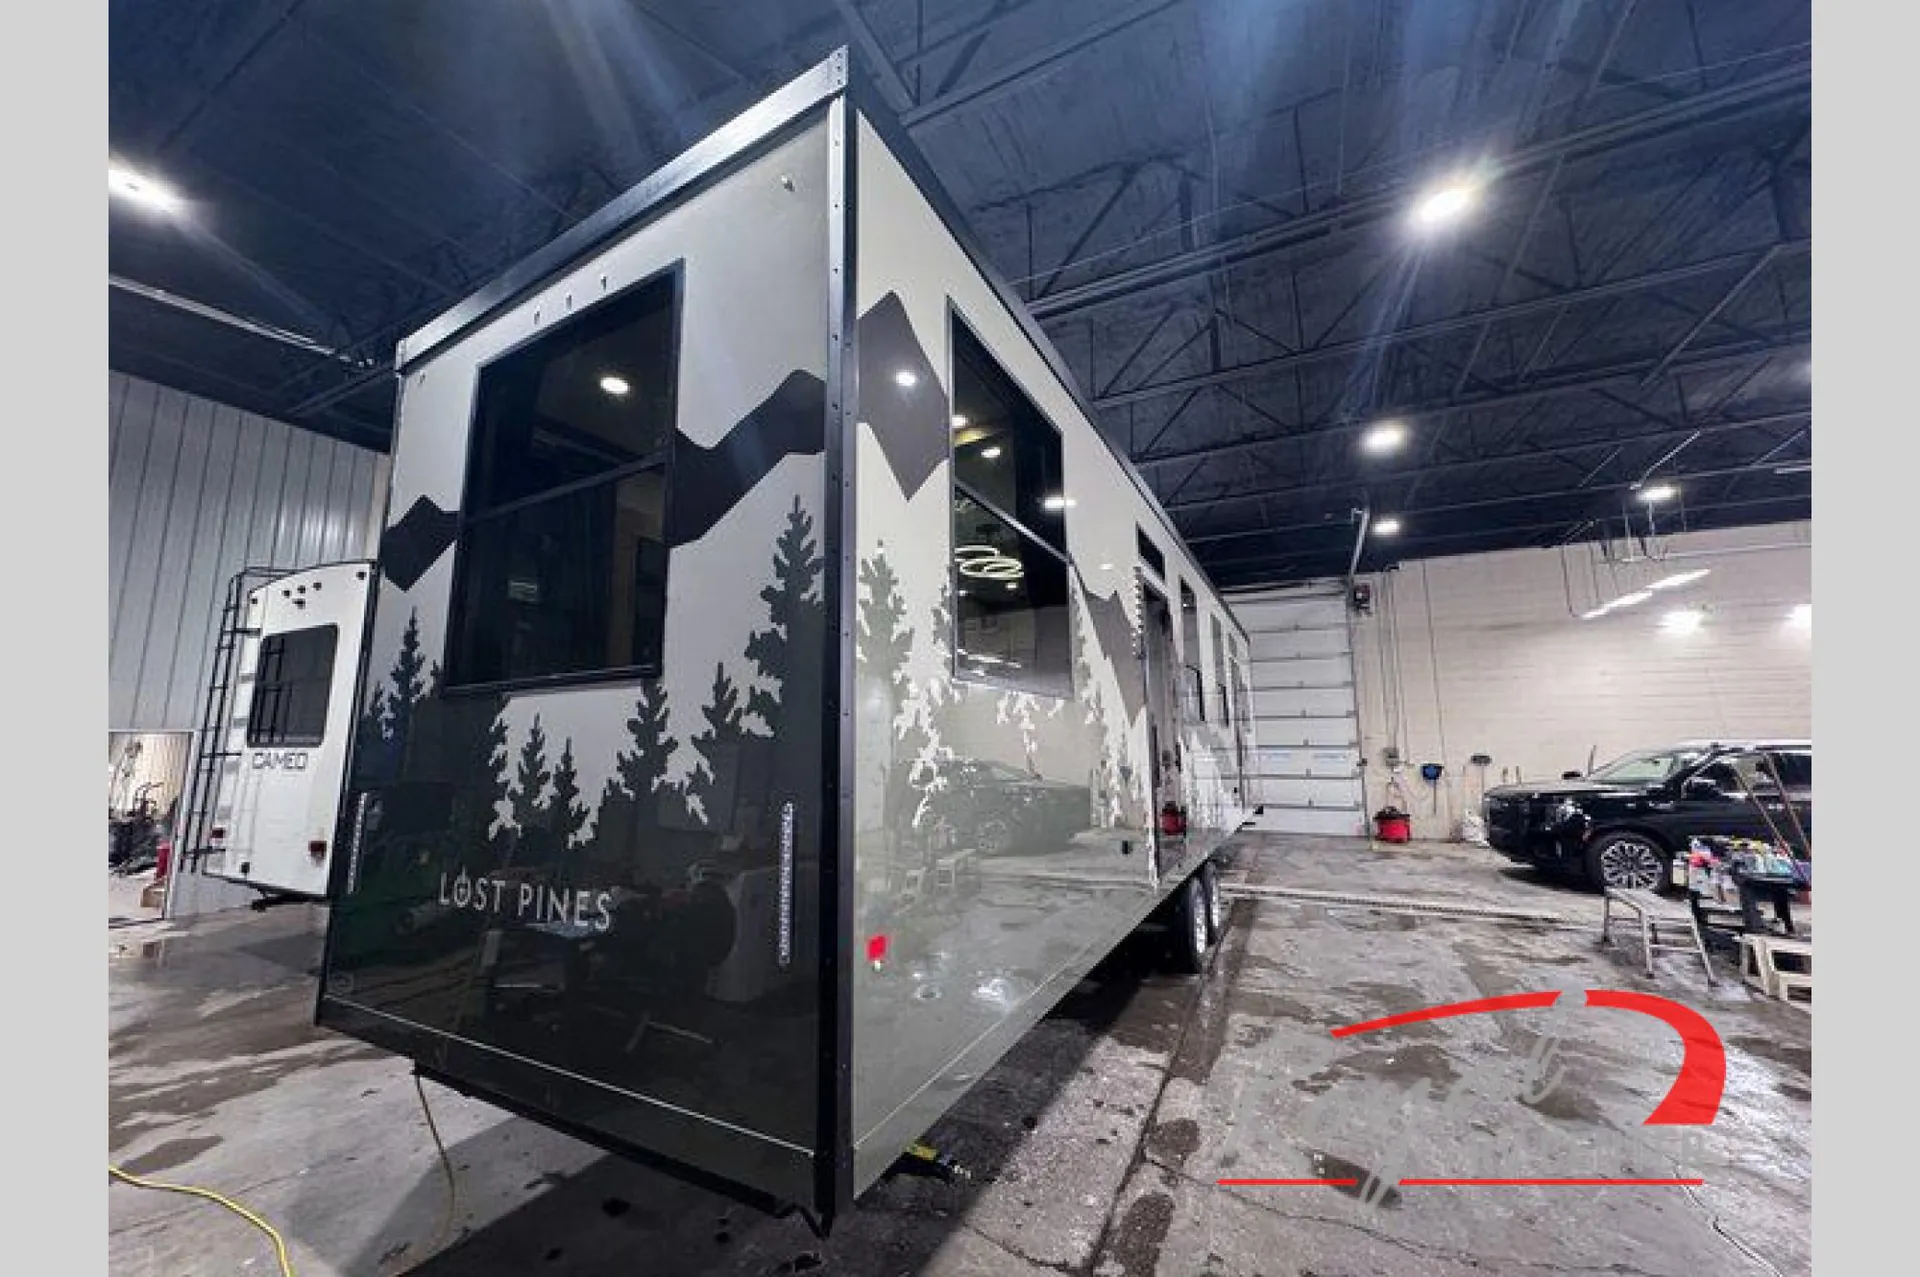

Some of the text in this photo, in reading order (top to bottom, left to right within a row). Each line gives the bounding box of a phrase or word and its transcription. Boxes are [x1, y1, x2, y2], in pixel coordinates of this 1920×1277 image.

[252, 752, 309, 770] CAMEO
[438, 866, 612, 932] LOST PINES
